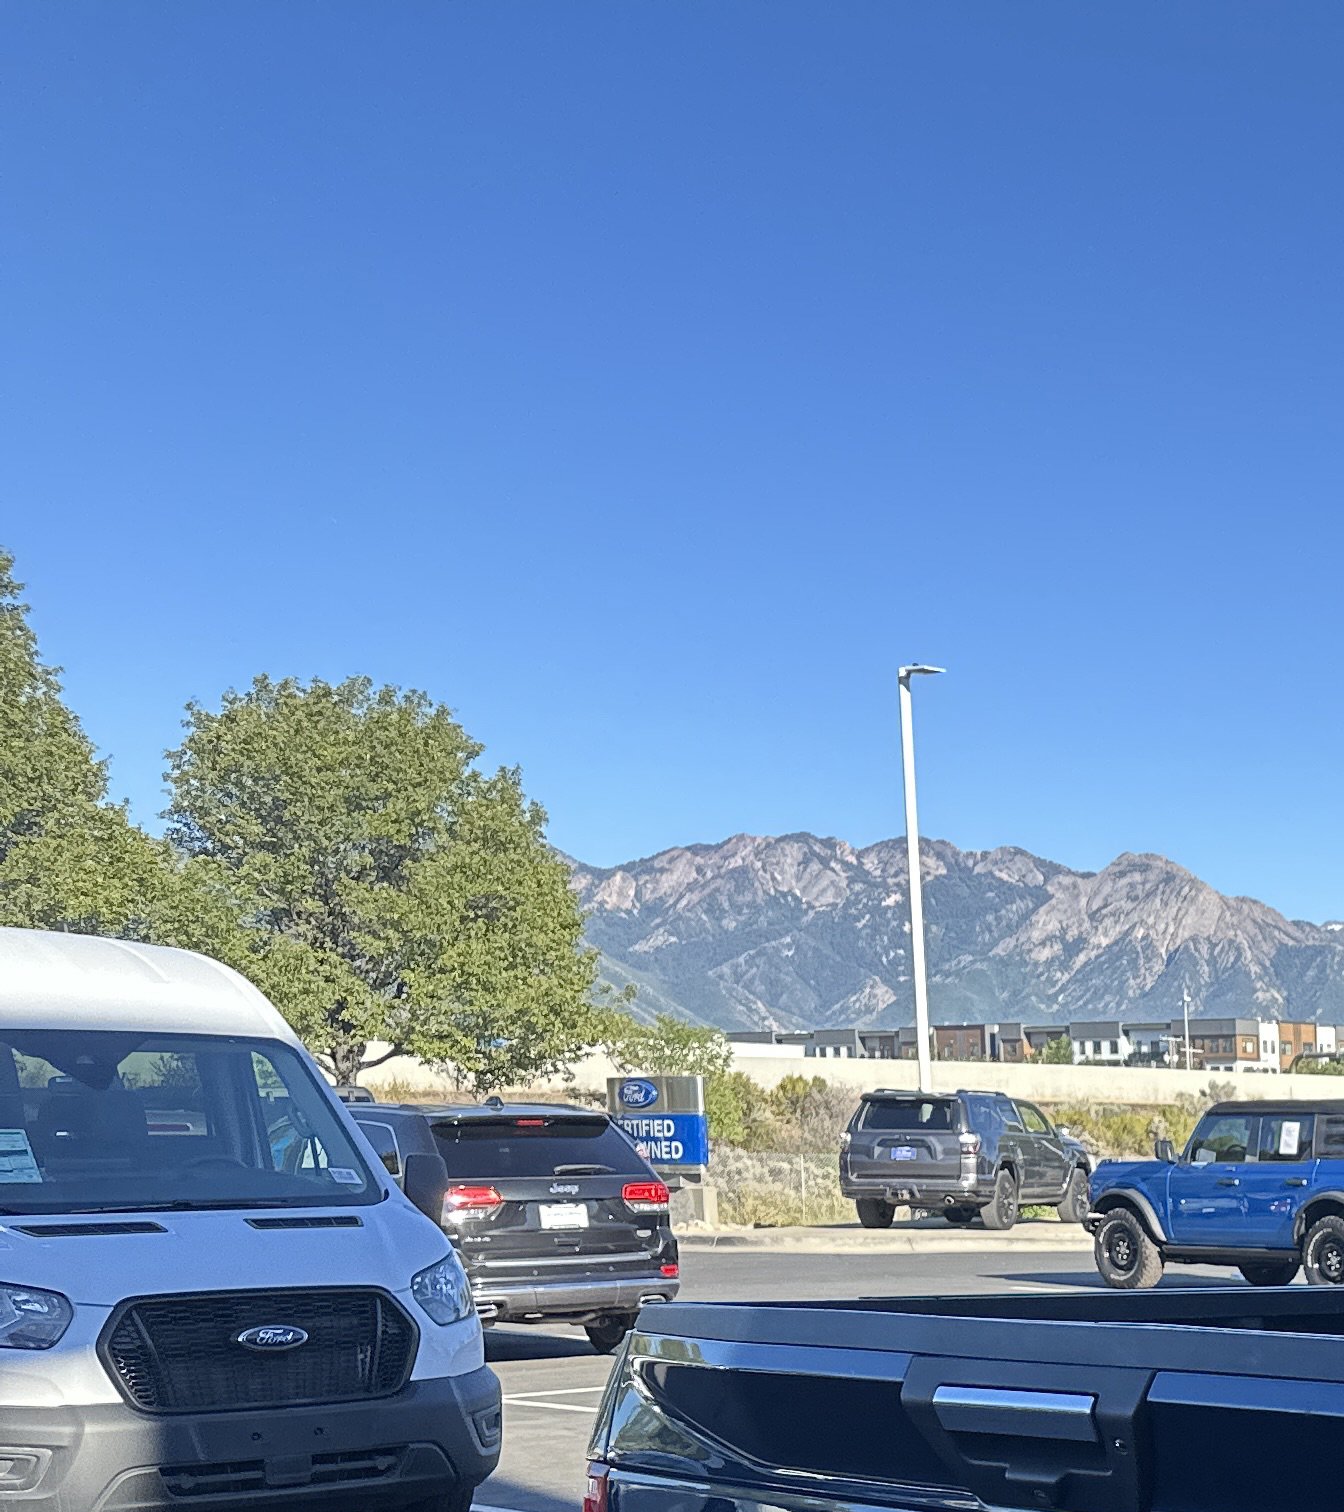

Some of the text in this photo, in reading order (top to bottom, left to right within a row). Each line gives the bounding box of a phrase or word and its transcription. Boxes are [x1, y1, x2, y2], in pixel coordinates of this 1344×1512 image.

[618, 1119, 675, 1138] RTIFIED
[549, 1183, 580, 1195] Jeep
[256, 1328, 294, 1345] Ford
